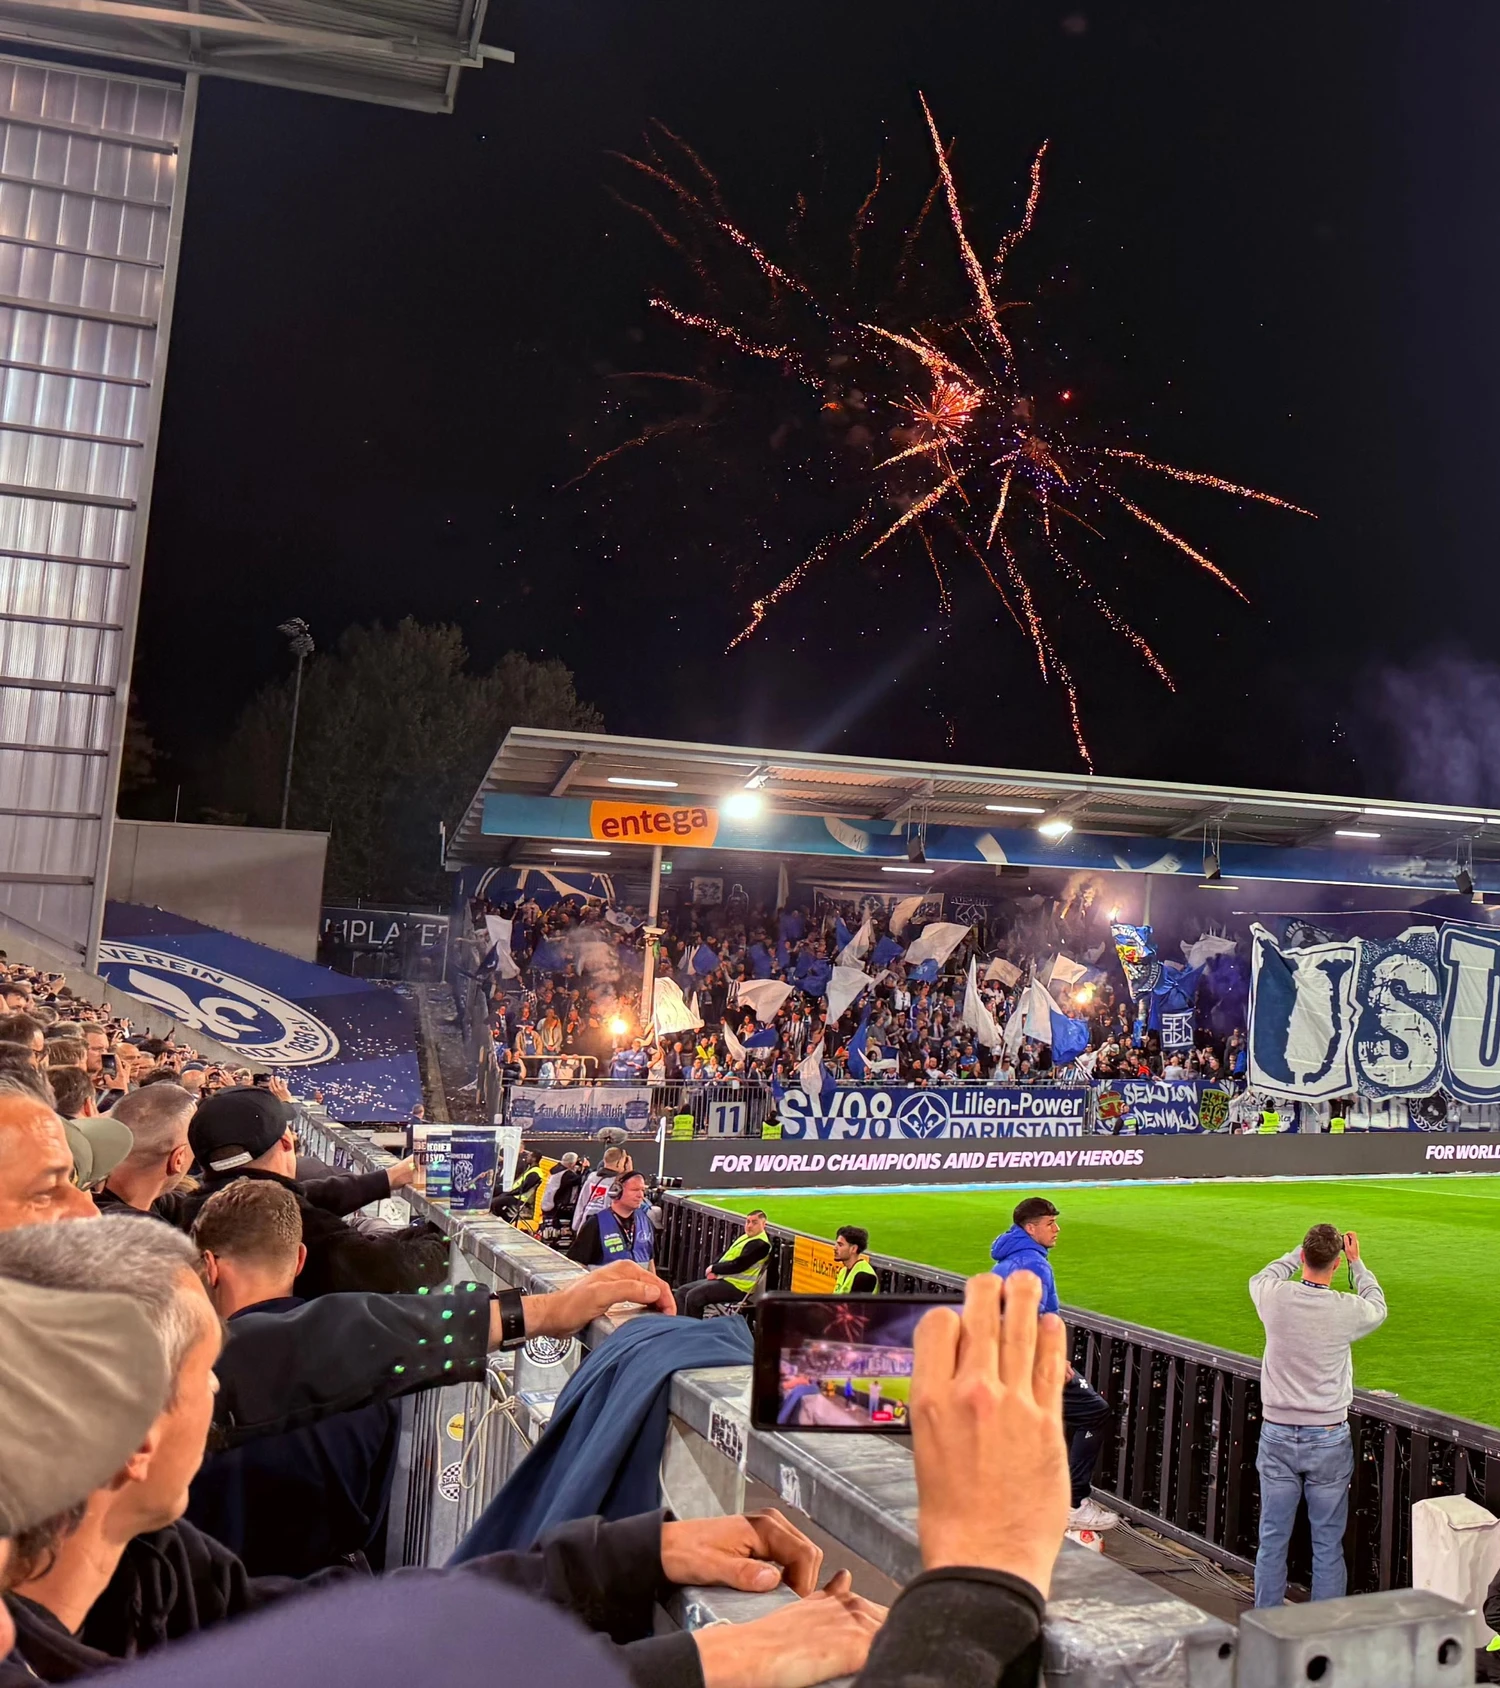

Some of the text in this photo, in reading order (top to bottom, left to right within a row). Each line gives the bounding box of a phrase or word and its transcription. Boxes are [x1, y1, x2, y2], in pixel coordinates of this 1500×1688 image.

[601, 808, 708, 838] entega
[99, 948, 224, 984] VEREIN
[715, 1106, 740, 1133] 11
[779, 1088, 1083, 1140] SV98 Lilien-Power
[950, 1121, 1082, 1138] DARMSTADT
[710, 1149, 1145, 1172] FOR WORLD CHAMPIONS AND EVERYDAY HEROES
[1426, 1145, 1456, 1160] FOR
